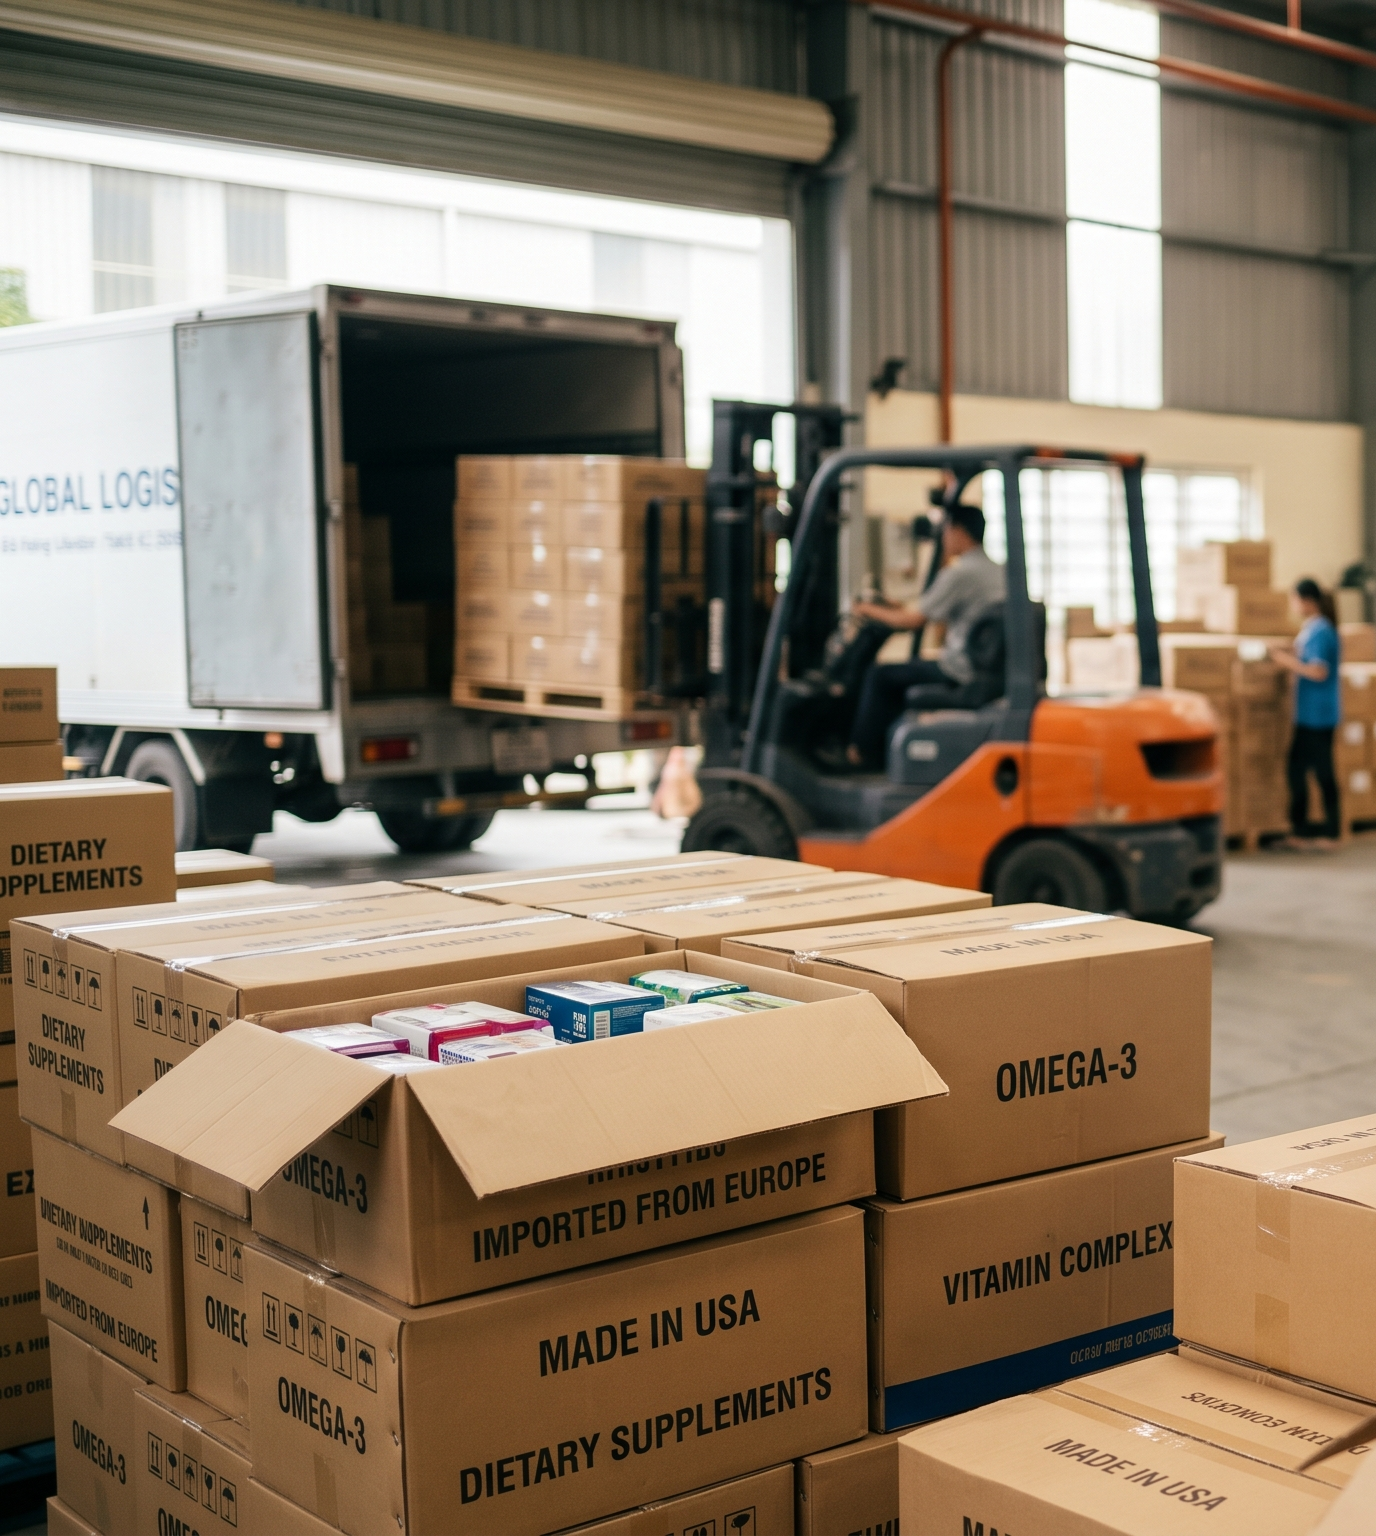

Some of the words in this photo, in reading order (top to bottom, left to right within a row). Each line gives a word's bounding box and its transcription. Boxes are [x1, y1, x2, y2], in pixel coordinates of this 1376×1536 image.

[10, 838, 107, 867] DIETARY
[939, 941, 1019, 956] MADE
[1015, 937, 1050, 947] IN
[1047, 932, 1104, 943] USA
[28, 1042, 104, 1095] SUPPLEMENTS
[41, 1013, 86, 1053] DIETARY
[996, 1042, 1138, 1103] OMEGA-3
[473, 1199, 626, 1263] IMPORTED
[636, 1177, 715, 1226] FROM
[724, 1152, 826, 1204] EUROPE
[942, 1251, 1052, 1307] VITAMIN
[1059, 1220, 1174, 1279] COMPLEX
[45, 1277, 88, 1322] IMPORTED
[90, 1304, 116, 1339] FROM
[119, 1321, 158, 1364] EUROPE
[539, 1317, 639, 1377] MADE
[650, 1307, 683, 1350] IN
[695, 1289, 761, 1337] USA
[72, 1419, 127, 1485] OMEGA-3
[278, 1376, 367, 1455] OMEGA-3
[460, 1432, 601, 1505] DIETARY
[610, 1367, 832, 1461] SUPPLEMENTS
[1043, 1438, 1136, 1475] MADE
[1124, 1468, 1169, 1488] IN
[1159, 1481, 1228, 1512] USA
